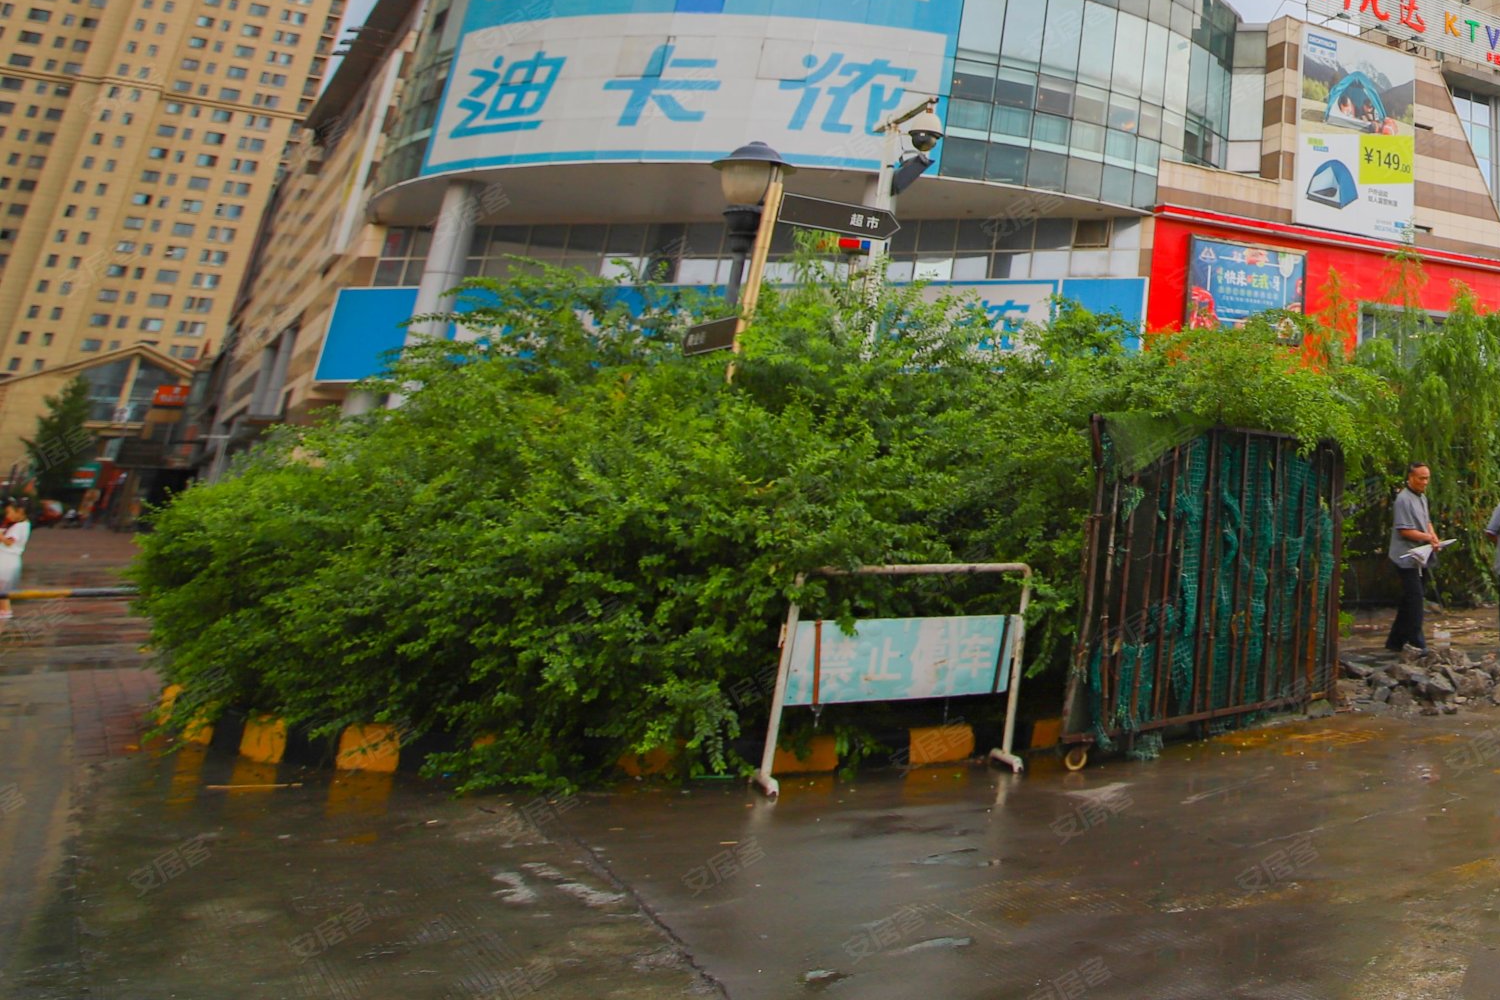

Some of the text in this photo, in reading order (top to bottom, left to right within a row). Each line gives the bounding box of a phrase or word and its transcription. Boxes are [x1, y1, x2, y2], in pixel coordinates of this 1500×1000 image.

[1444, 10, 1500, 50] KTV
[449, 44, 917, 140] 迪卡侬
[850, 213, 881, 230] 超市
[819, 633, 995, 684] 禁止停车
